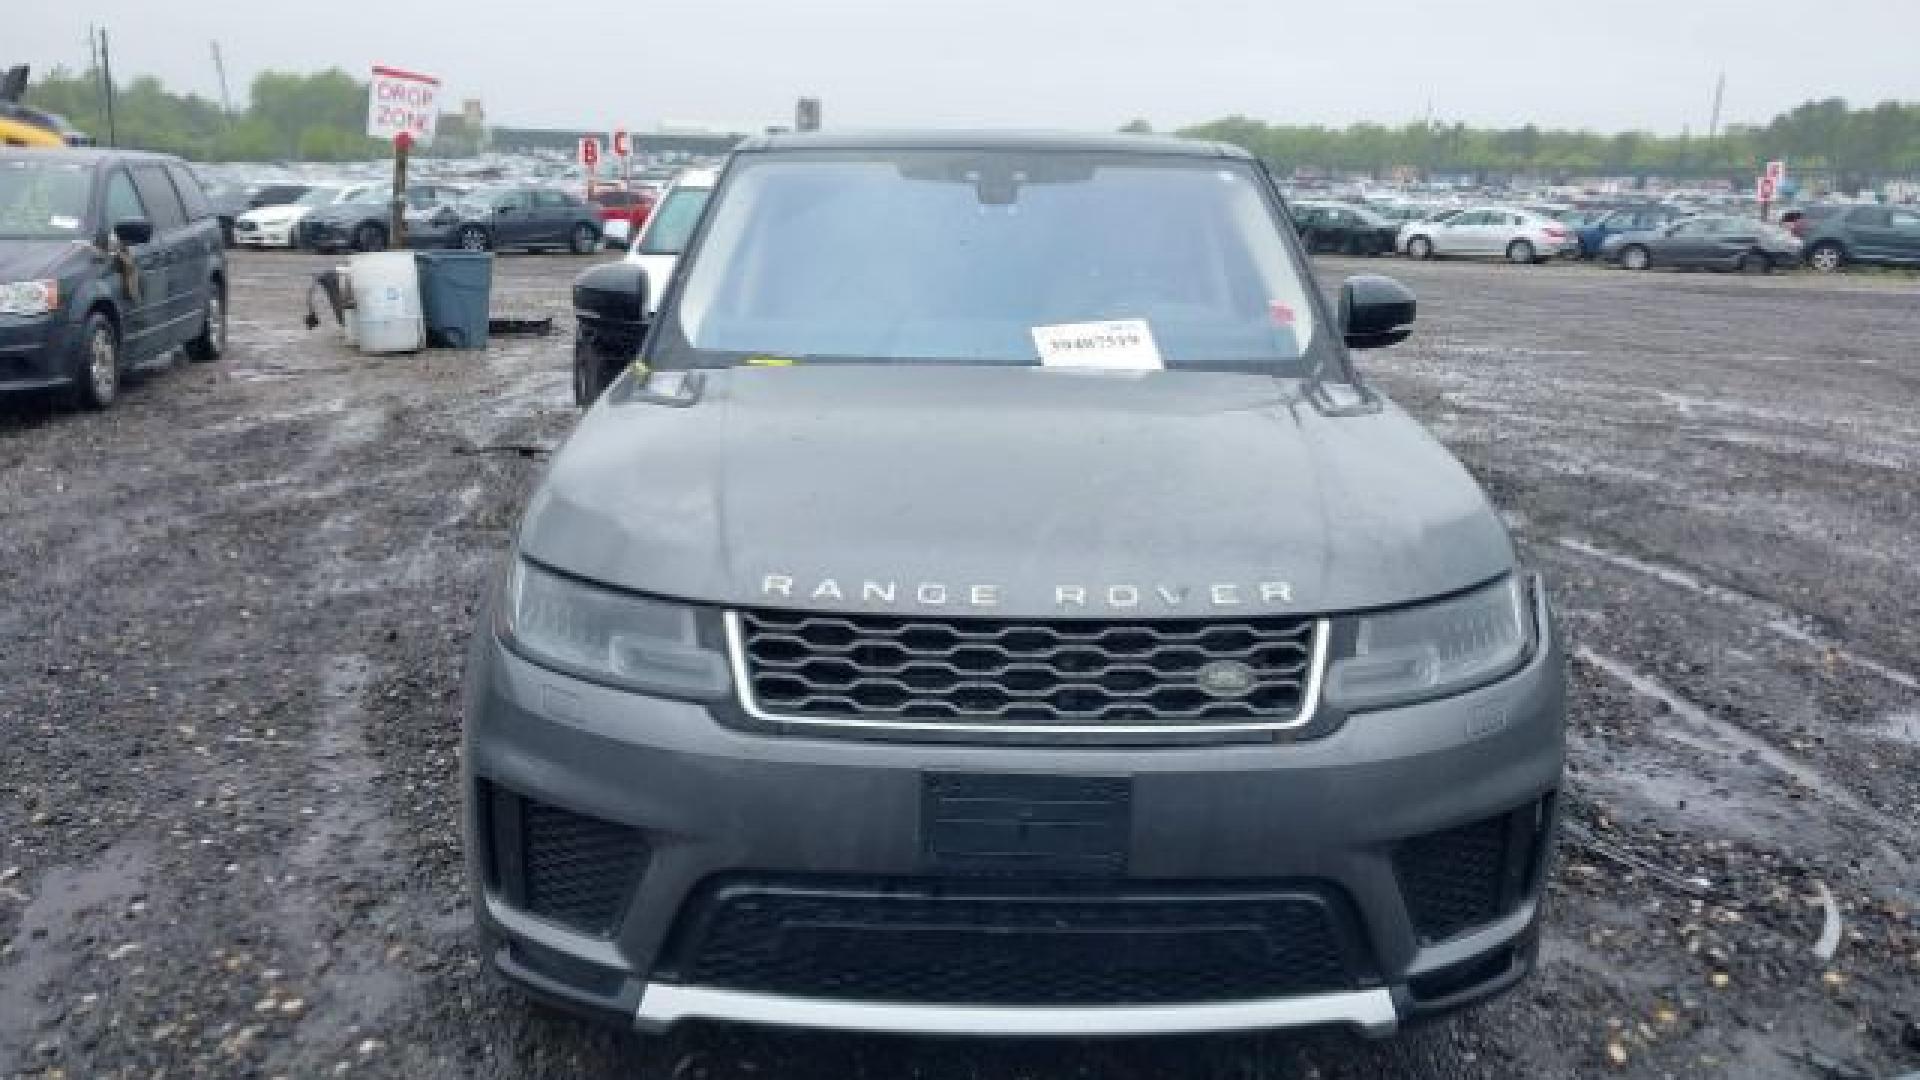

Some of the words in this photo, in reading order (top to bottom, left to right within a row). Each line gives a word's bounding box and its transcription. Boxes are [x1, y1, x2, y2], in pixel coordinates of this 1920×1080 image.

[377, 83, 433, 106] DROP
[584, 139, 598, 165] B
[614, 131, 628, 156] C
[761, 574, 1000, 607] RANGE
[1055, 580, 1294, 607] ROVER
